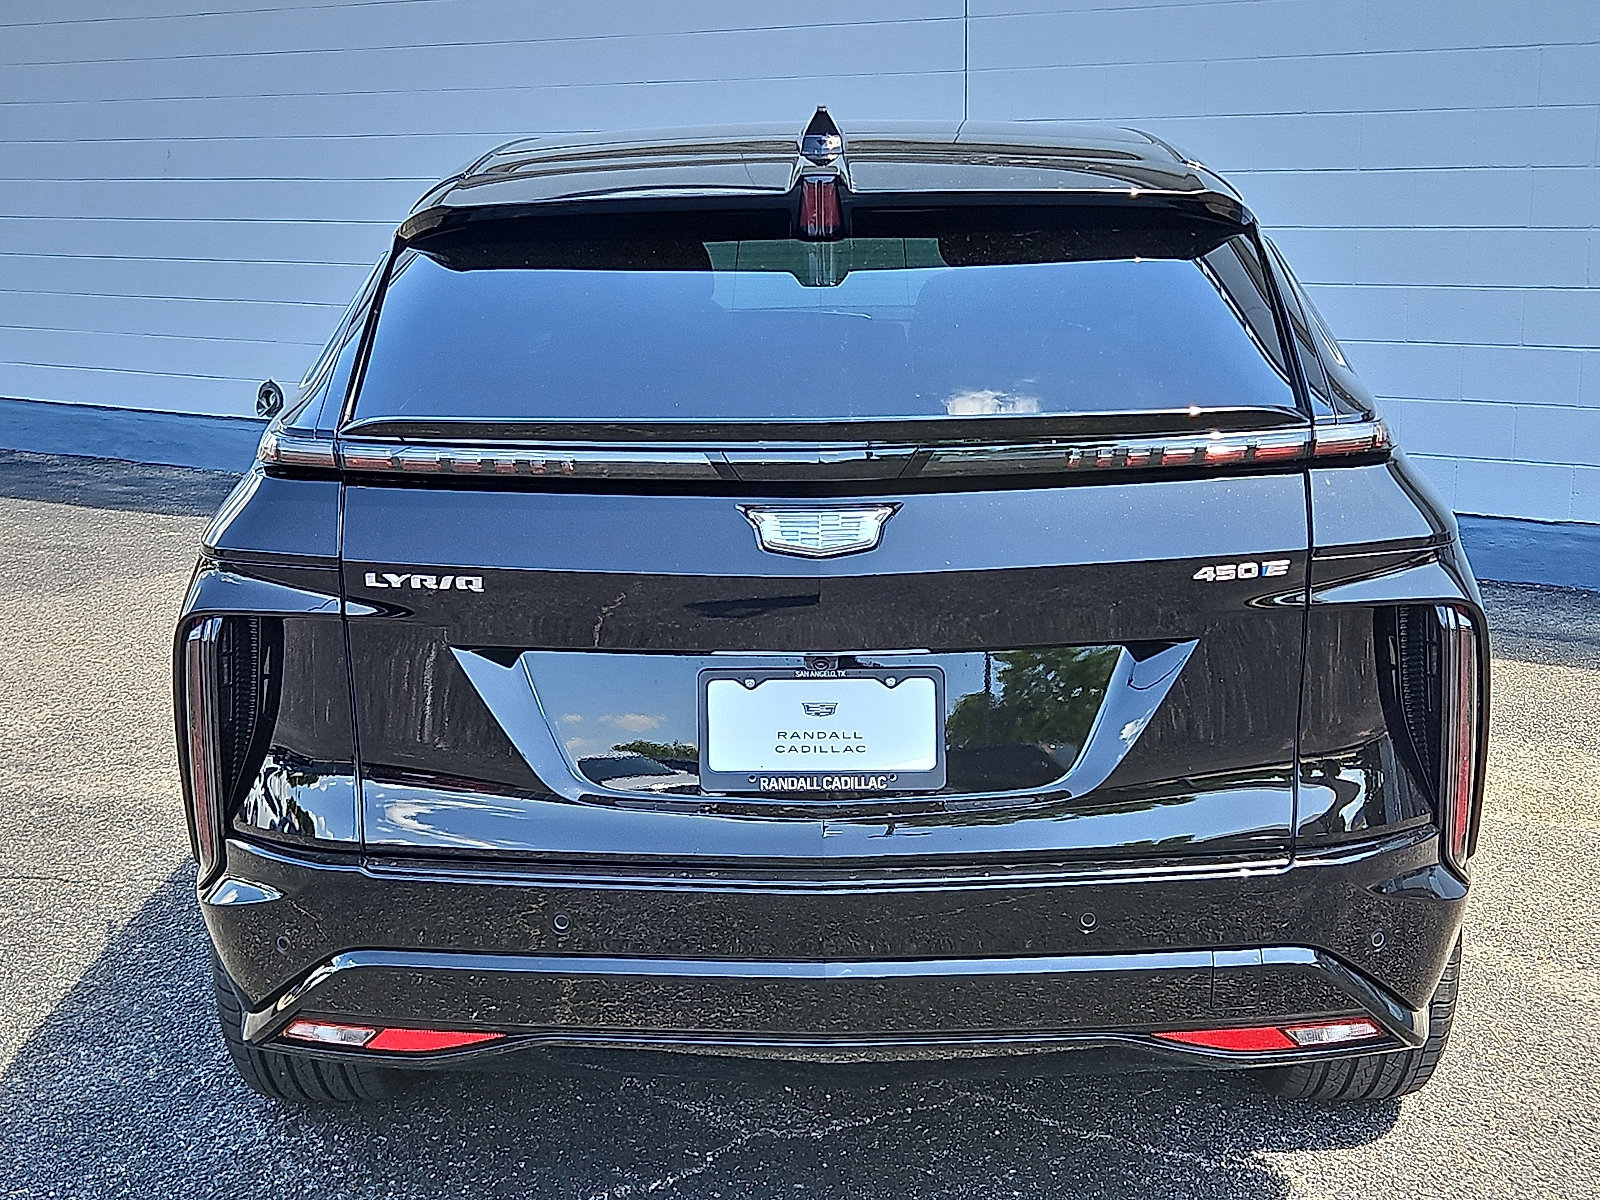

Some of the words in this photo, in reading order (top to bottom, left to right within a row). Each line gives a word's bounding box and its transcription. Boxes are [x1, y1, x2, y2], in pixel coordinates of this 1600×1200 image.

[365, 573, 484, 592] LYRIQ
[777, 731, 863, 739] RANDALL
[775, 745, 866, 753] CADILLAC
[760, 776, 819, 790] RANDALL
[822, 775, 887, 789] CADILLAC
